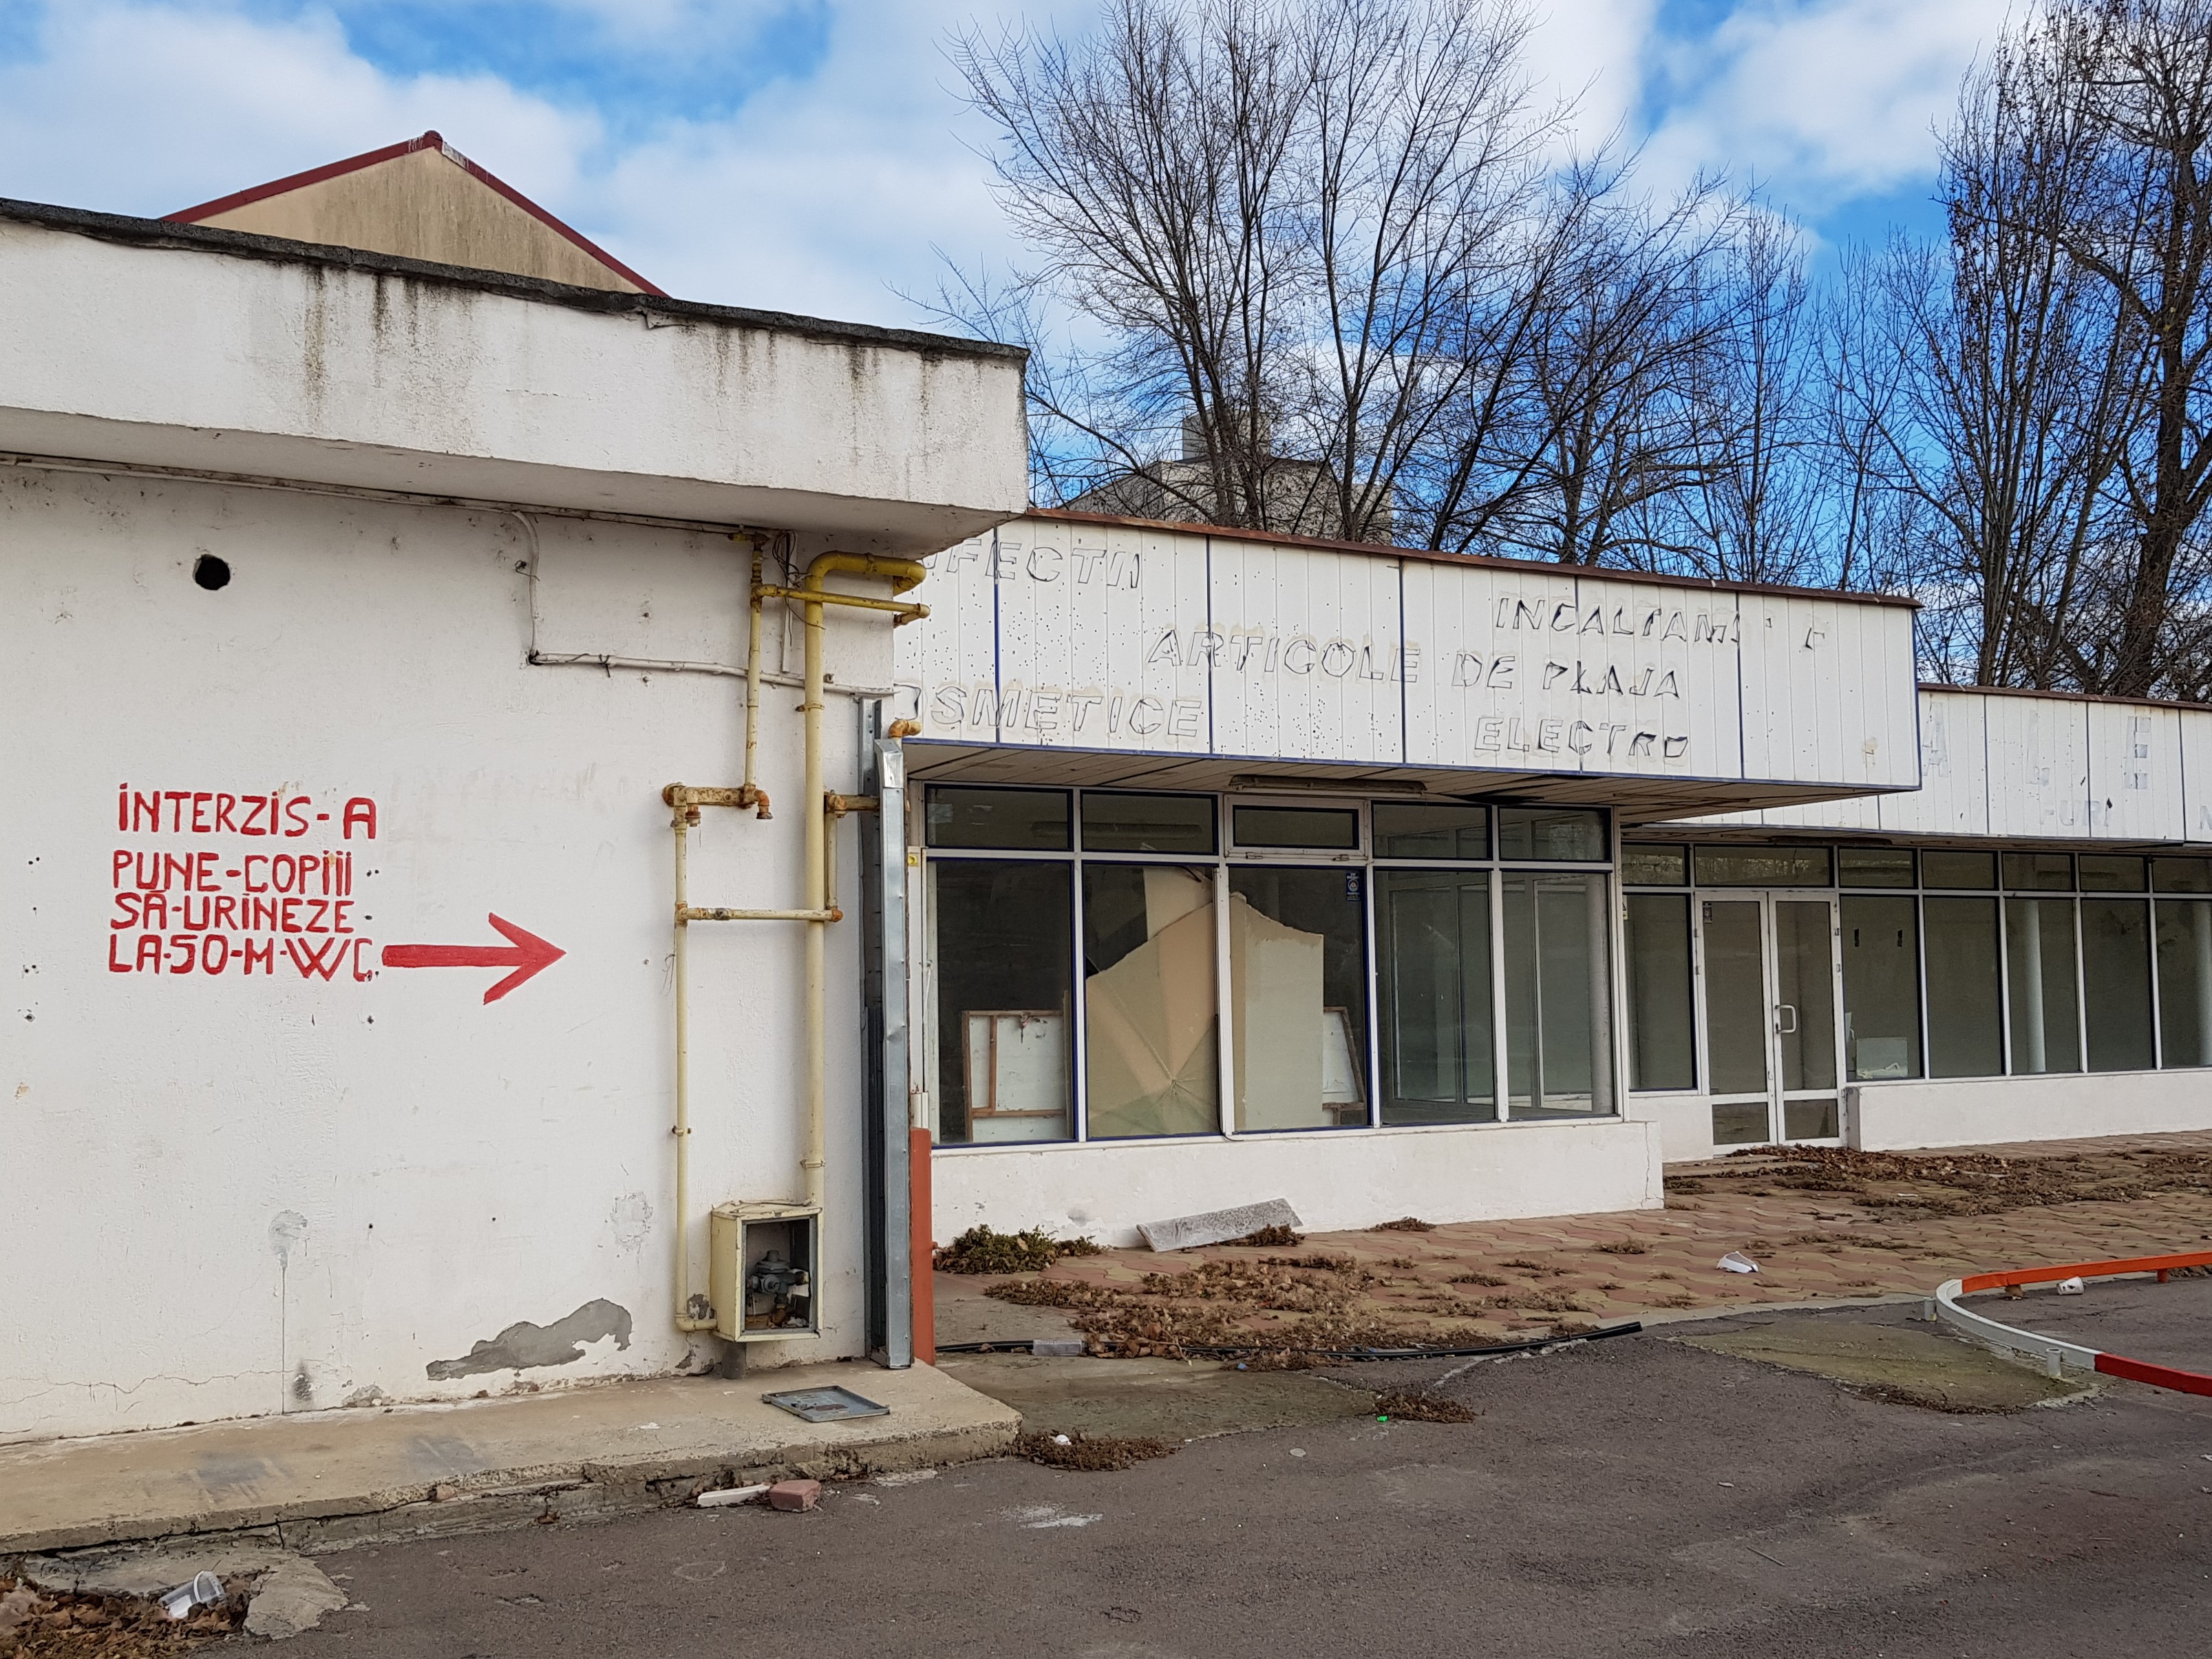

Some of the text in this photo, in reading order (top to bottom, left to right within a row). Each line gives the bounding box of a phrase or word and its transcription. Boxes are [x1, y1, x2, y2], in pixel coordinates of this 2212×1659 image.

[1147, 628, 1680, 699] ARTICOLE DE PLAJA
